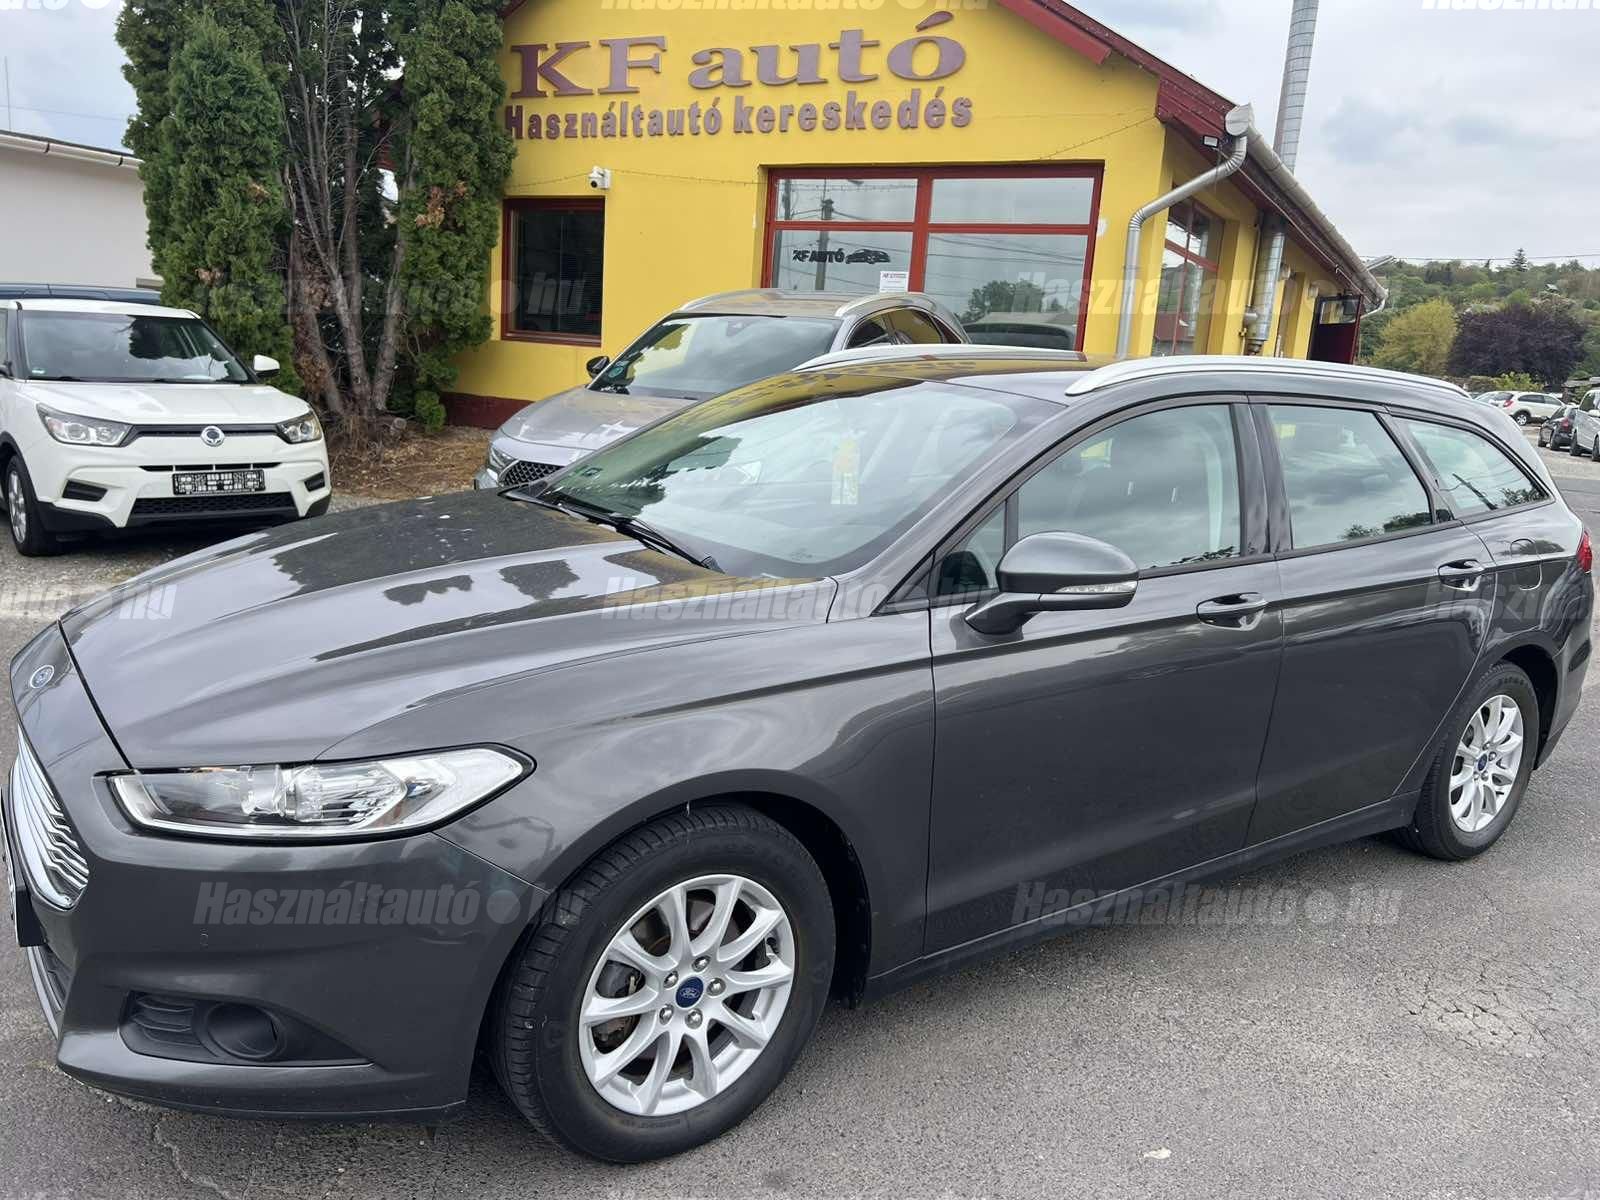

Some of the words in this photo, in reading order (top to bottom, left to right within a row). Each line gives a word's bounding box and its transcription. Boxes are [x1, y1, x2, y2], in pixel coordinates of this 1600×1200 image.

[511, 36, 668, 98] KF
[688, 10, 966, 89] autó
[505, 97, 722, 141] Használtautó
[733, 86, 973, 134] kereskedés
